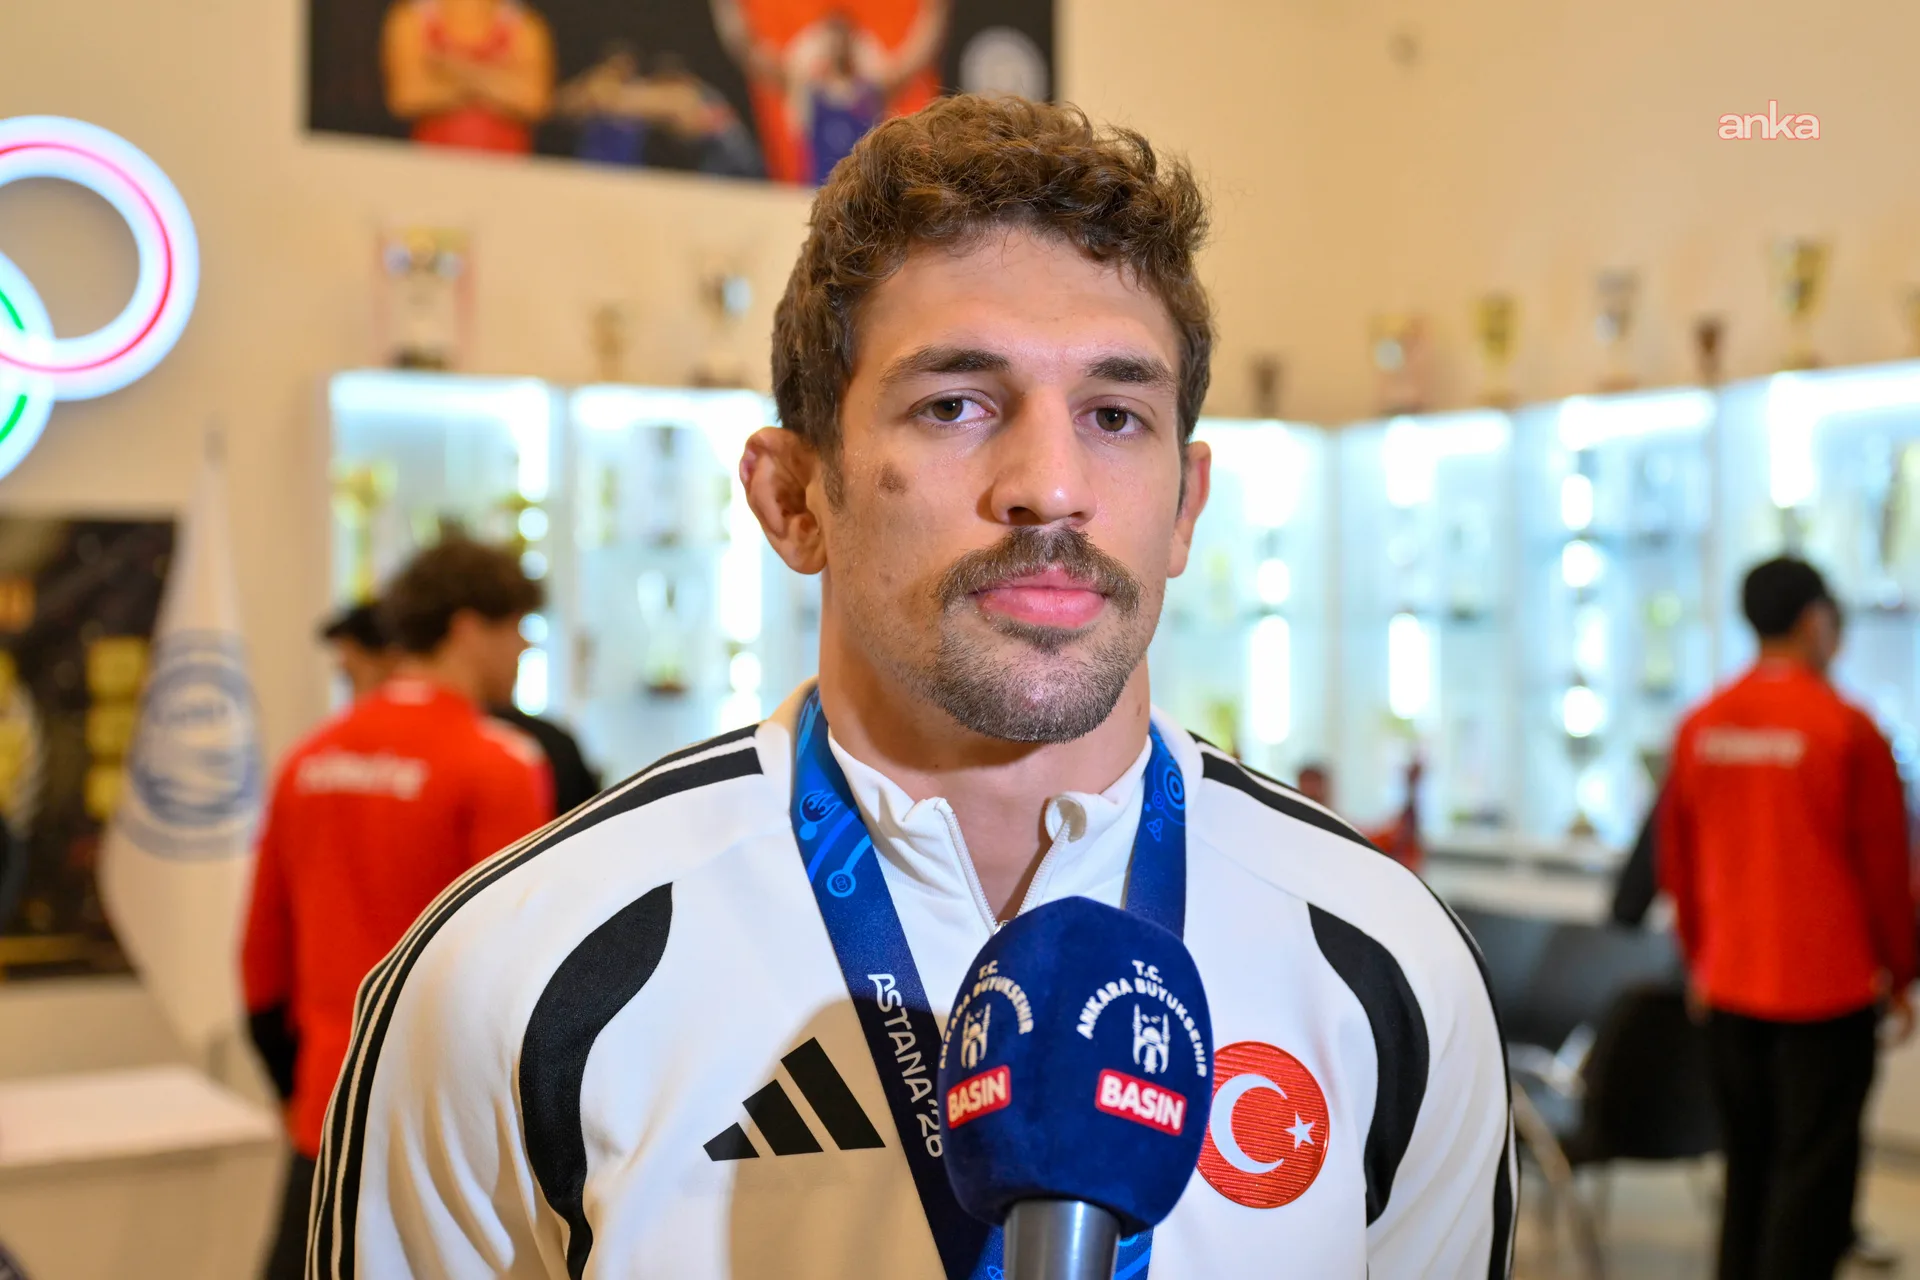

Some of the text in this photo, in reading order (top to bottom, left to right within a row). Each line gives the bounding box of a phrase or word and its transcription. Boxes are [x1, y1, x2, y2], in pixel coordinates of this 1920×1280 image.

[1132, 960, 1163, 984] T.C.
[1077, 978, 1133, 1040] ANKARA
[947, 1071, 1006, 1123] BASIN
[1100, 1074, 1184, 1130] BASIN
